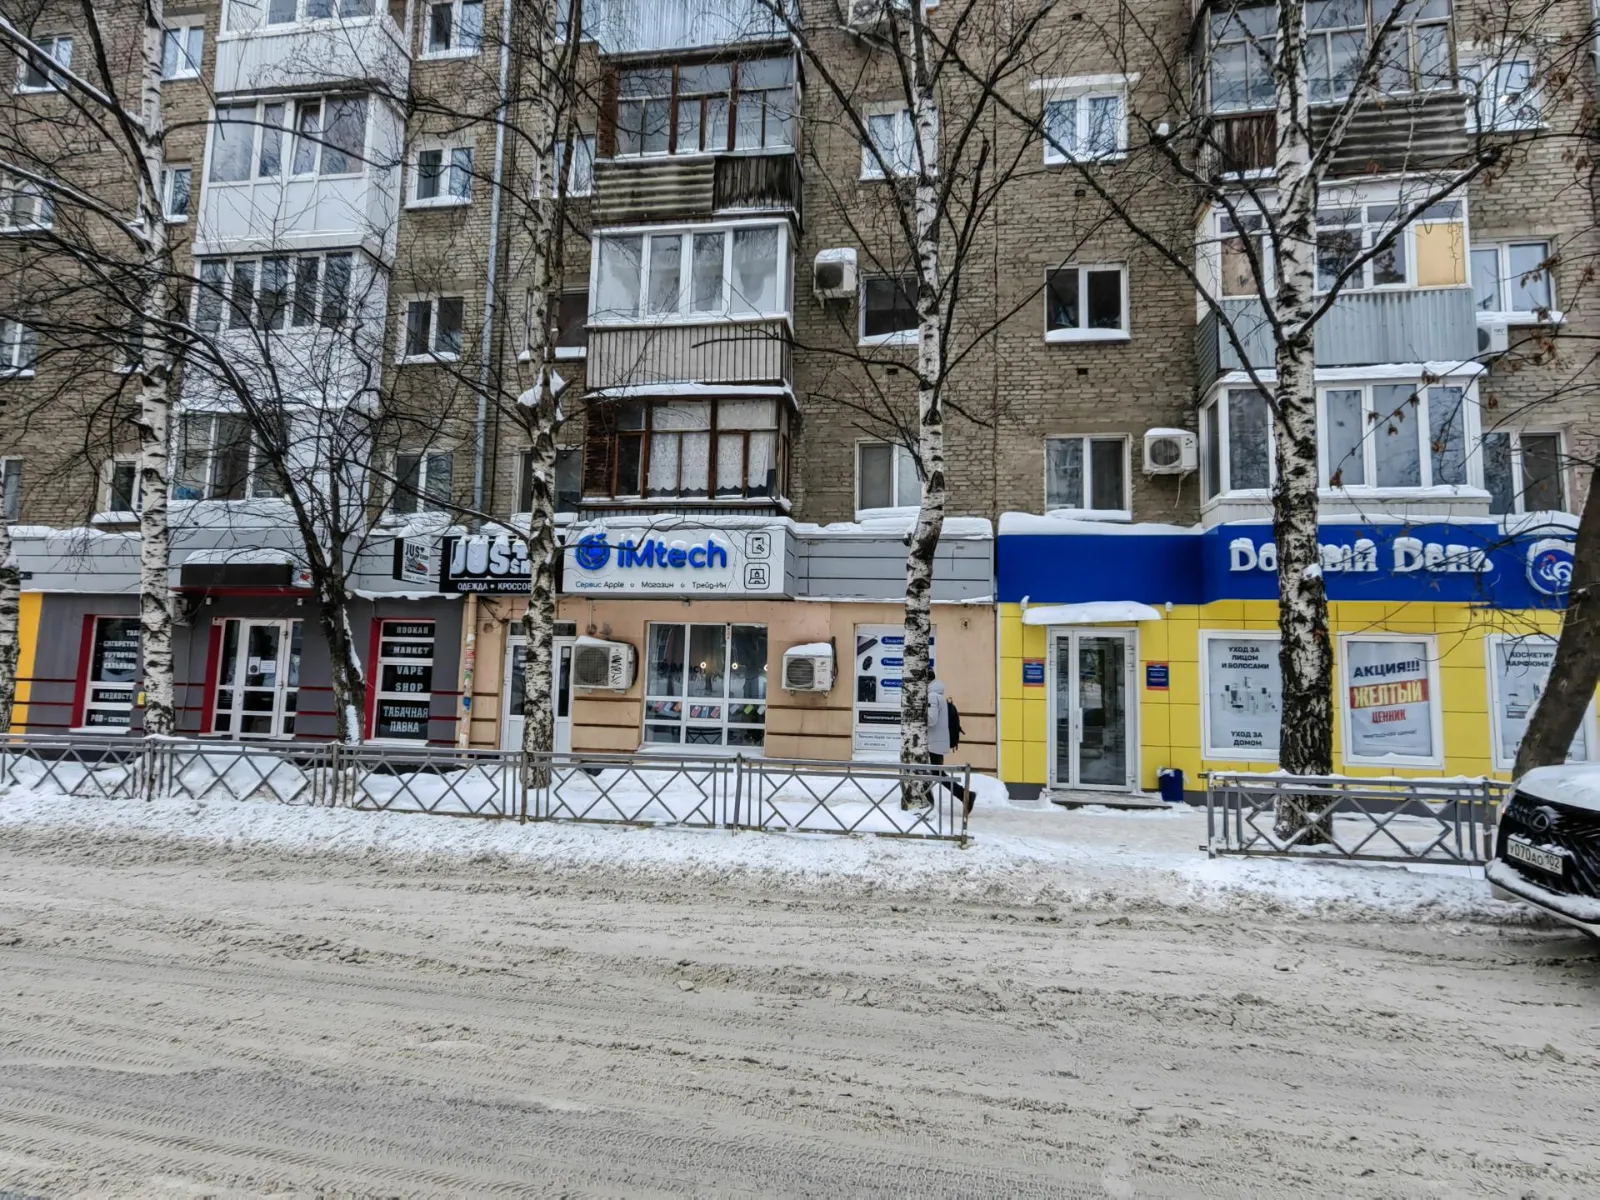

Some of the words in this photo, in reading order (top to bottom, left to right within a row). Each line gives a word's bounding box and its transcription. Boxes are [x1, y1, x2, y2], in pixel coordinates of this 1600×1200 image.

[451, 538, 528, 574] JUST
[457, 582, 488, 590] ОДЕЖДА
[497, 582, 532, 591] КРОССОВ
[575, 580, 601, 589] Сервис
[603, 580, 625, 589] Apple
[641, 581, 674, 589] Магазин
[692, 581, 727, 590] Трейд-Ин
[393, 646, 429, 654] MARKET
[397, 666, 423, 675] VAPE
[1353, 660, 1420, 678] АКЦИЯ!!!
[395, 682, 423, 692] SHOP
[1354, 680, 1422, 708] ЖЕЛТЫЙ
[383, 706, 429, 718] ТАБАЧНАЯ
[1372, 709, 1406, 723] ЦЕННИК
[390, 721, 419, 733] ЛАВКА
[1544, 854, 1560, 868] 102
